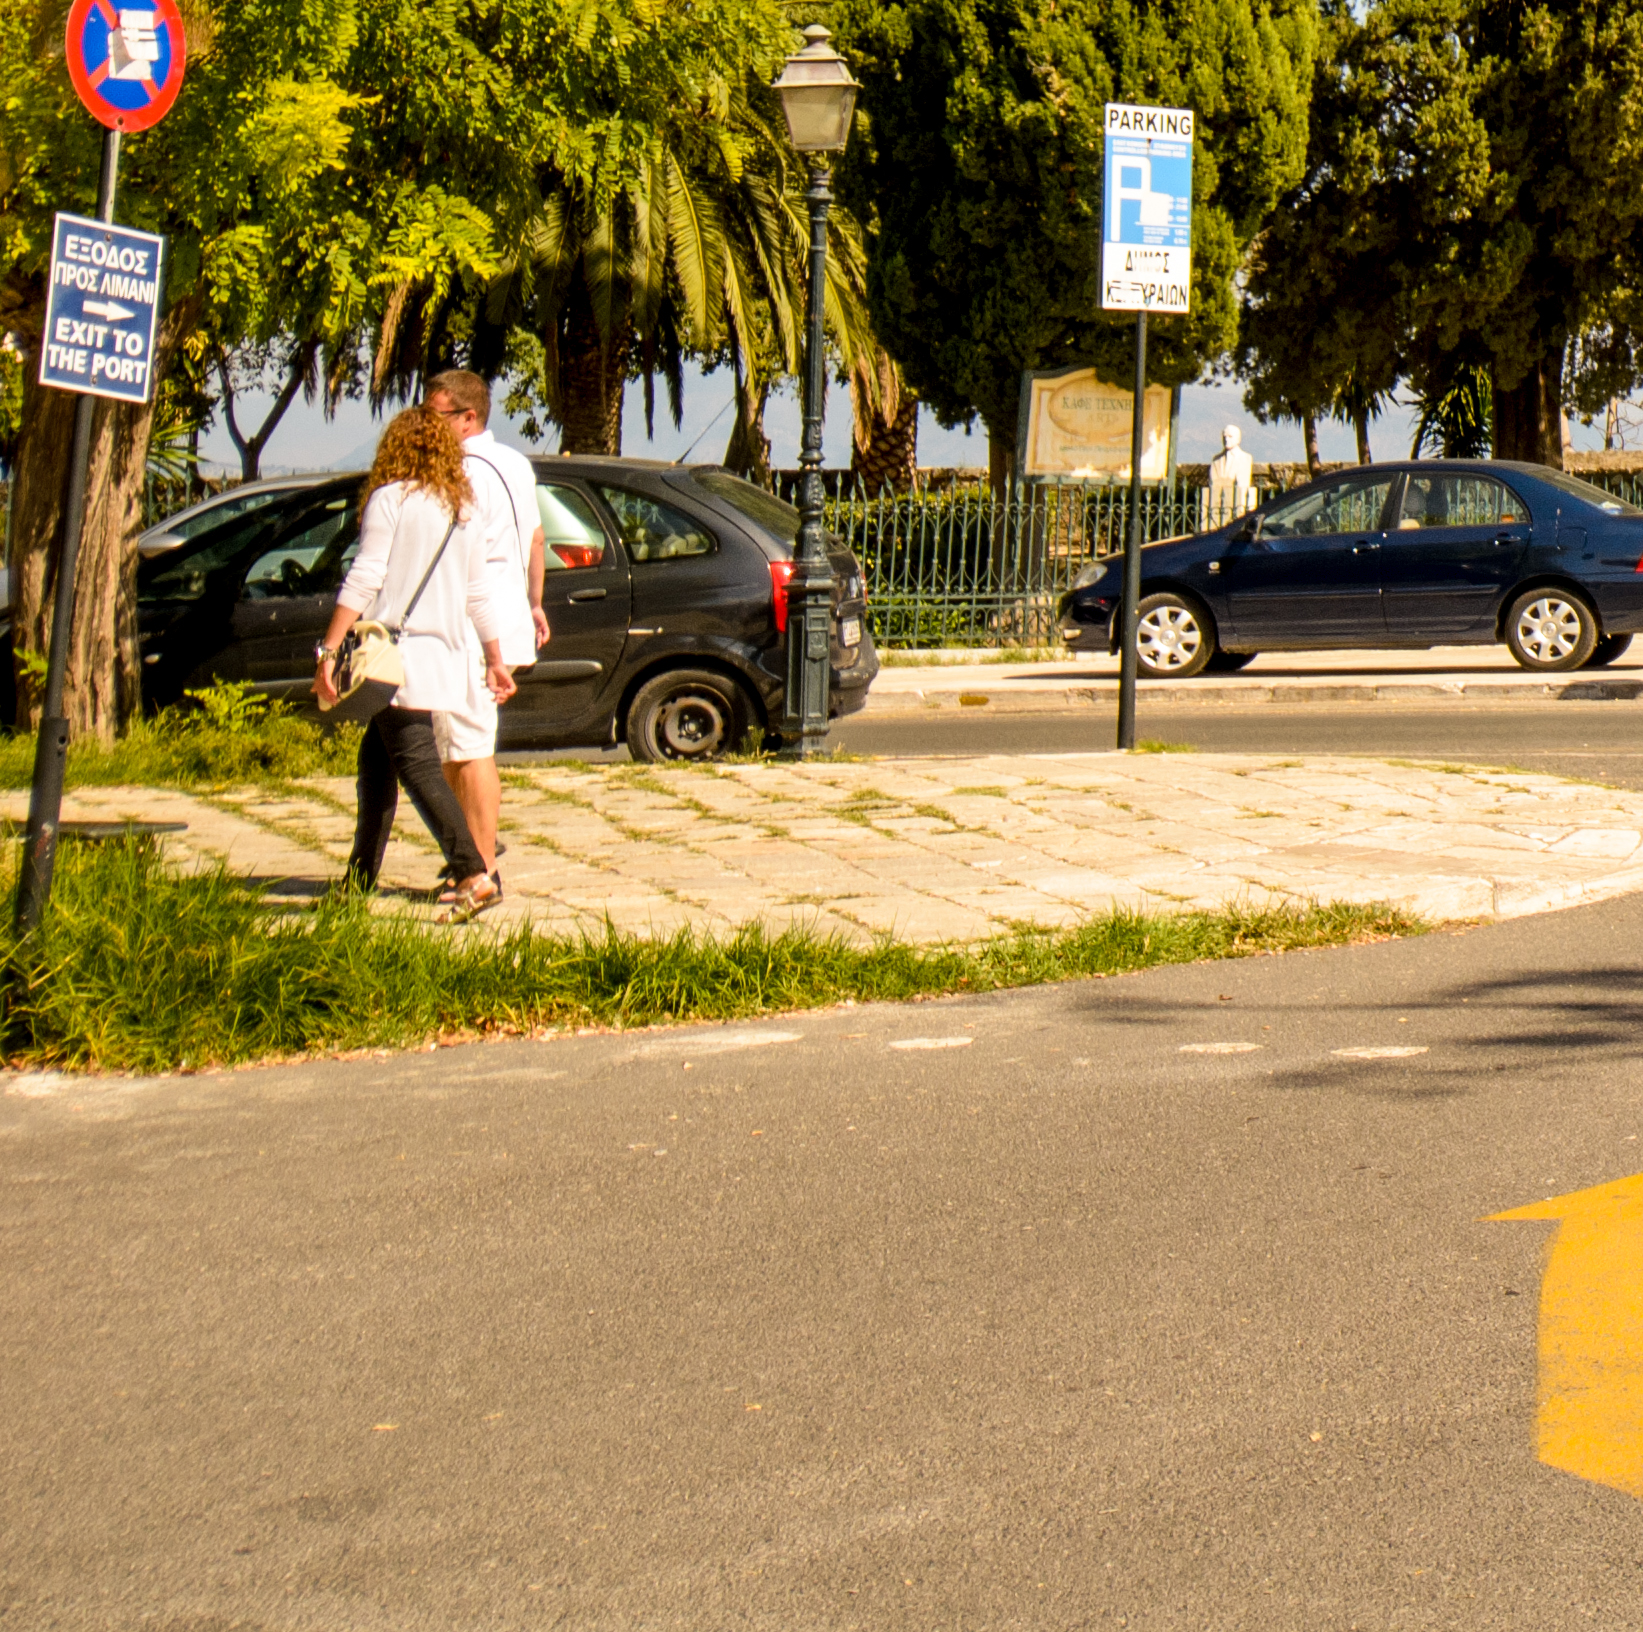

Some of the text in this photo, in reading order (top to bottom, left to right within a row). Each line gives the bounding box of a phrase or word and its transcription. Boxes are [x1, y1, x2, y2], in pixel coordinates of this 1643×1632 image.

[1108, 108, 1191, 136] PARKING
[65, 234, 149, 275] ΕΞΟΔΟΣ
[55, 261, 155, 304] ΠΡΟΣ ΛΙΜΑΝΙ
[1106, 280, 1188, 306] ΚΥΡΑΙΩΝ
[55, 317, 143, 356] EXIT TO
[48, 344, 147, 384] THE PORT
[1095, 398, 1133, 411] ΤΕΧΝΗ
